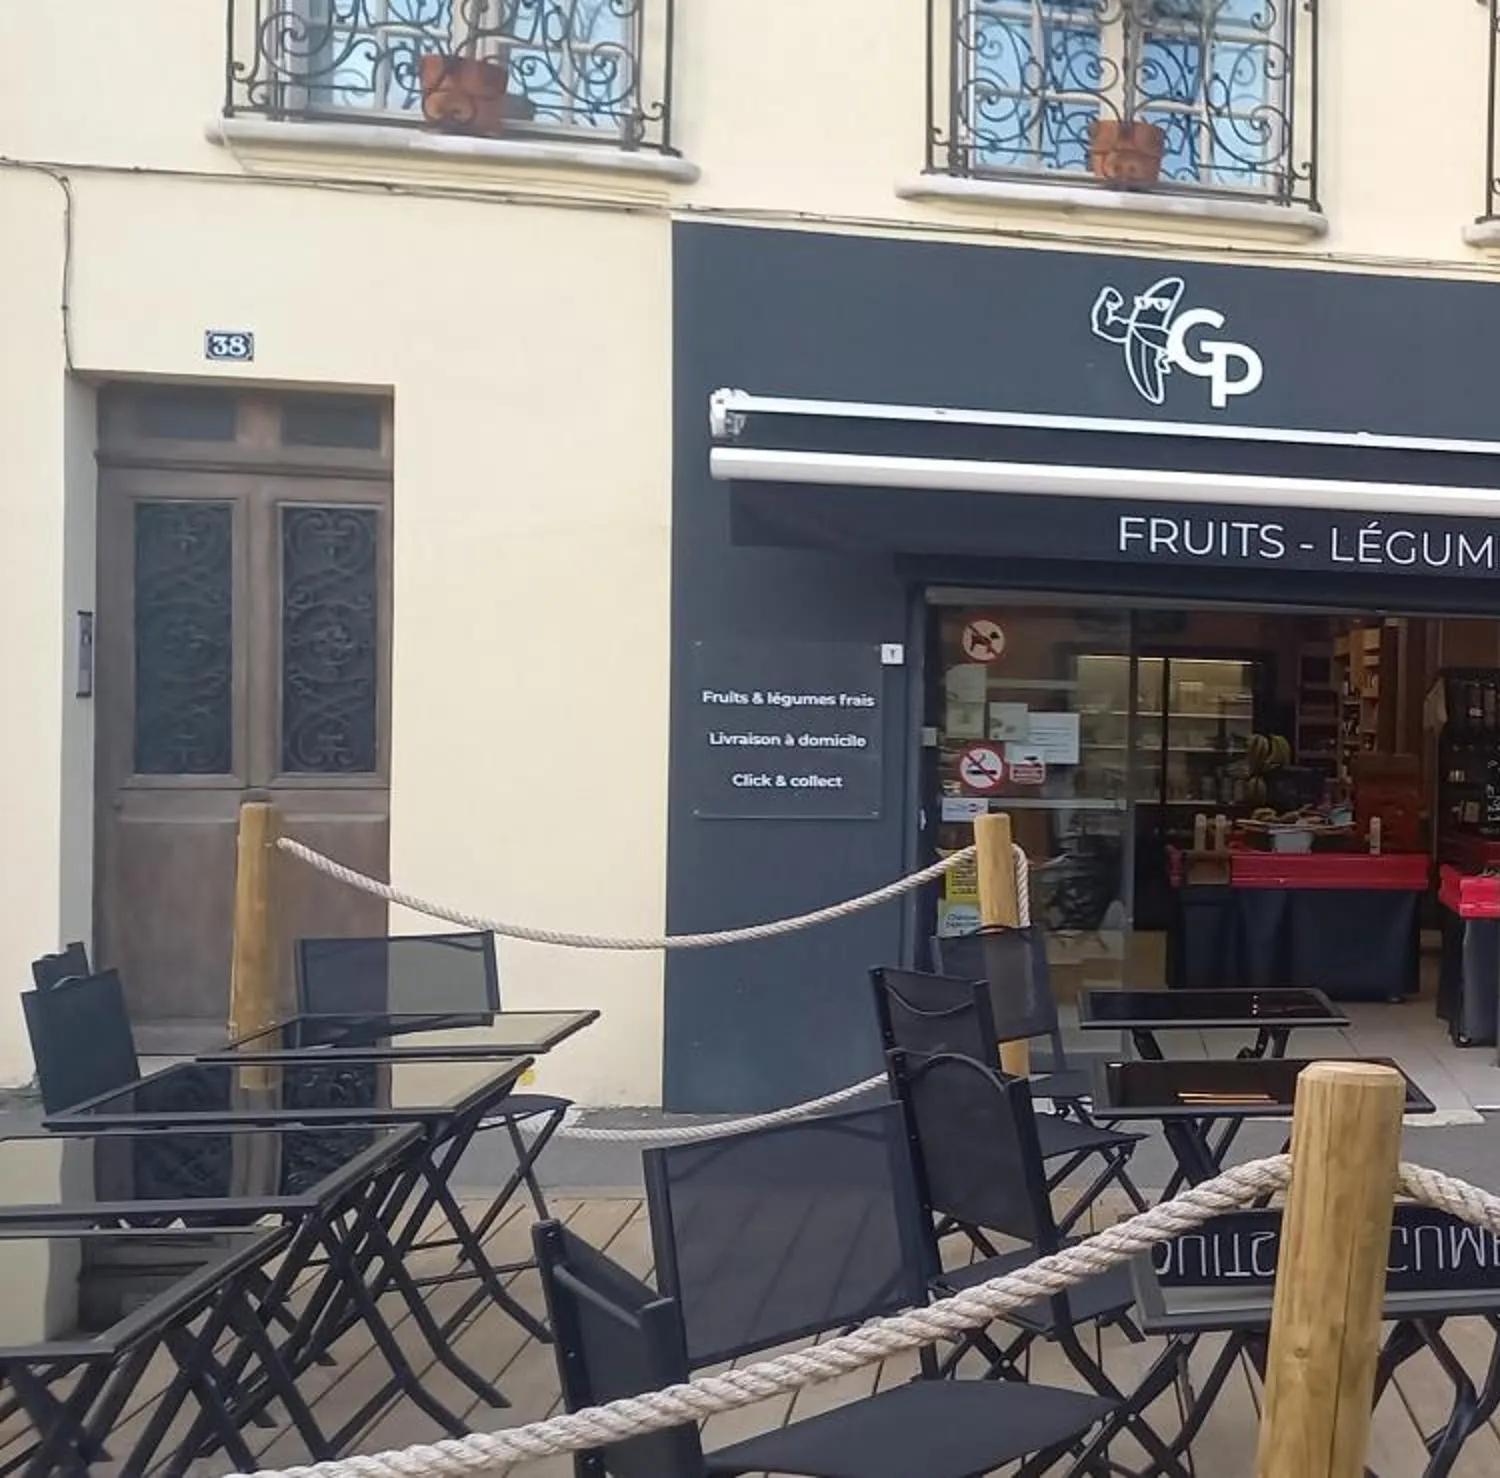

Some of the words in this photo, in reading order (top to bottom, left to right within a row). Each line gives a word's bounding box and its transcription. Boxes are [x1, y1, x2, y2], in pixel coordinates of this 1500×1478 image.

[213, 336, 246, 355] 38
[1119, 516, 1285, 559] FRUITS
[702, 690, 750, 705] Fruits
[751, 691, 765, 705] &
[767, 691, 837, 708] légumes
[839, 693, 875, 707] frais
[709, 731, 782, 746] Livraison
[784, 733, 795, 747] à
[797, 733, 867, 747] domicile
[731, 773, 773, 787] Click
[775, 774, 787, 787] &
[789, 774, 843, 788] collect
